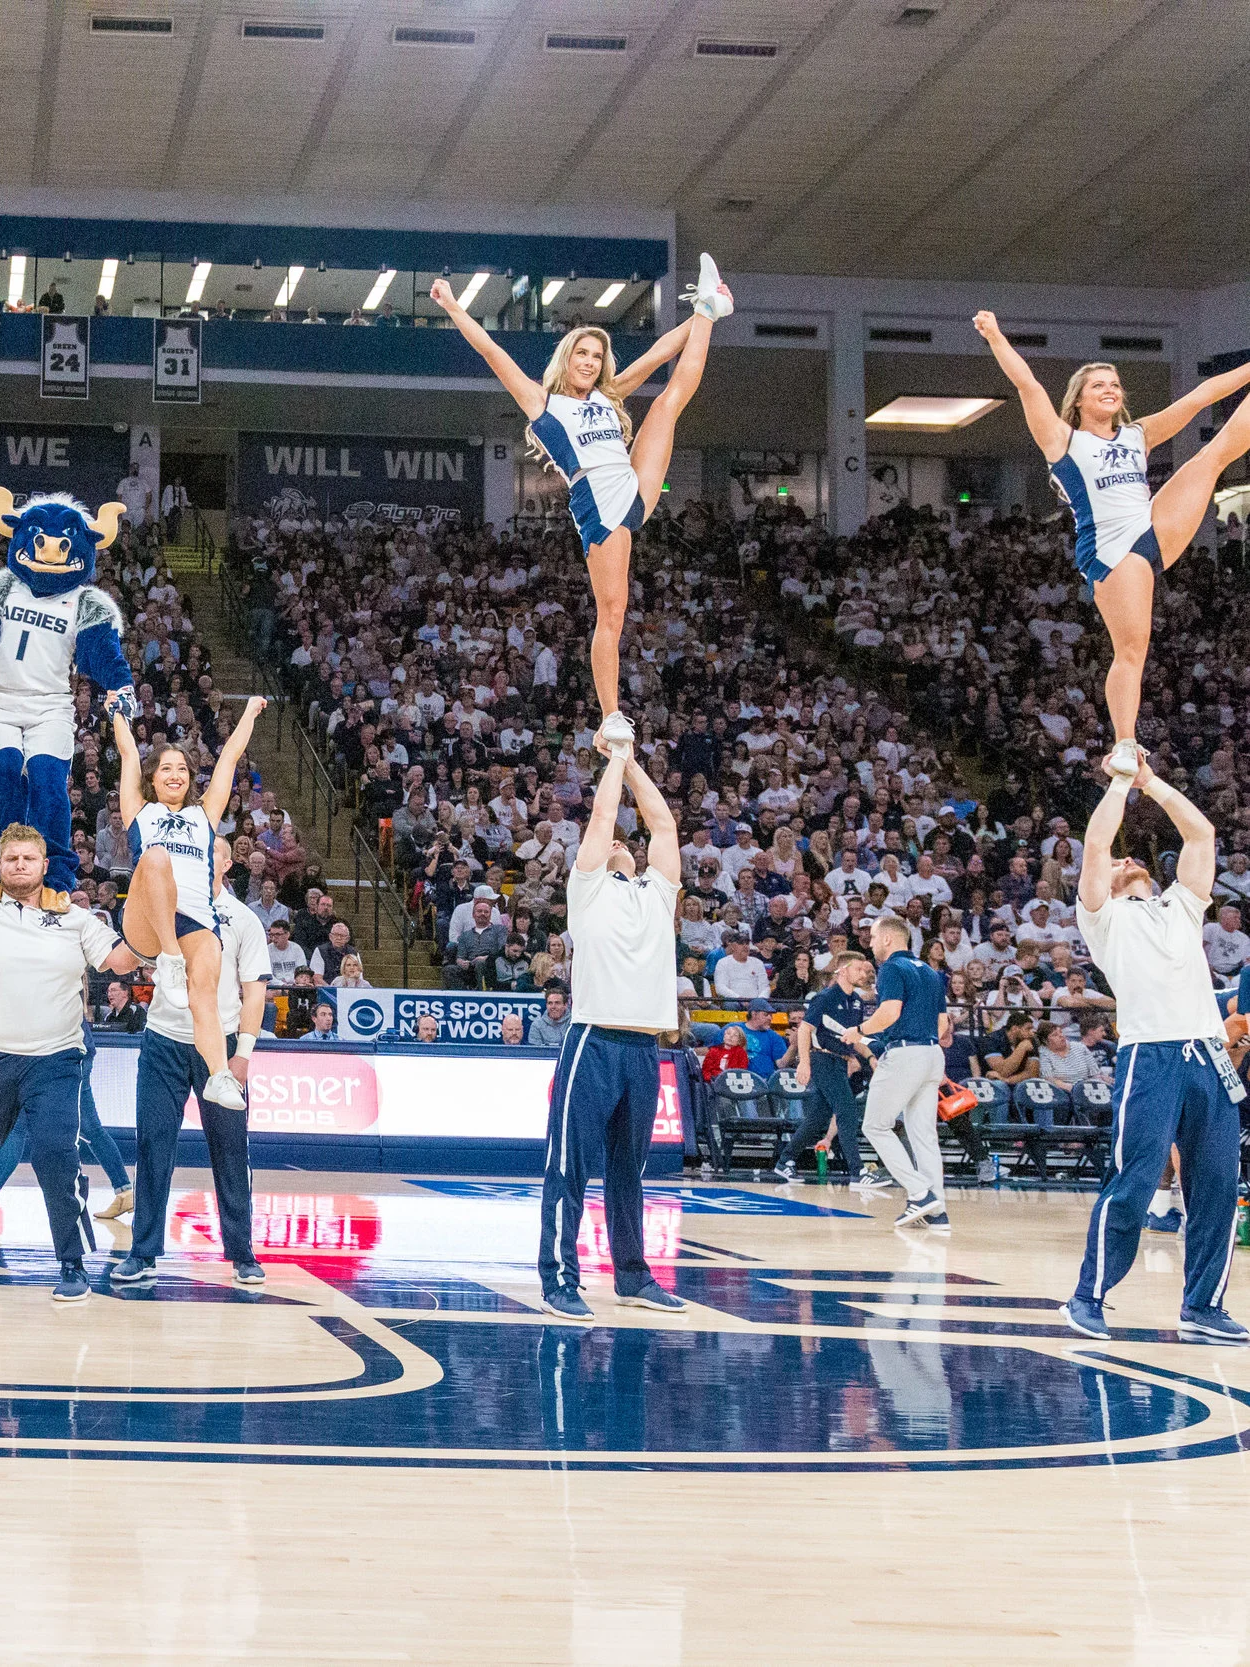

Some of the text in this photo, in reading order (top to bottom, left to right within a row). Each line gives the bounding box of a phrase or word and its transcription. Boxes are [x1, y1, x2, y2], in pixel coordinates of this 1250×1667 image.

[49, 353, 81, 372] 24
[163, 357, 191, 376] 31
[138, 432, 152, 448] A
[576, 430, 604, 447] UTAH
[6, 435, 70, 467] WE
[494, 445, 507, 460] B
[264, 445, 465, 482] WILL WIN
[1095, 473, 1127, 490] UTAH
[2, 604, 68, 635] AGGIES
[175, 843, 204, 862] STATE
[398, 1000, 542, 1021] CBS SPORTS
[399, 1019, 504, 1039] NTWOR
